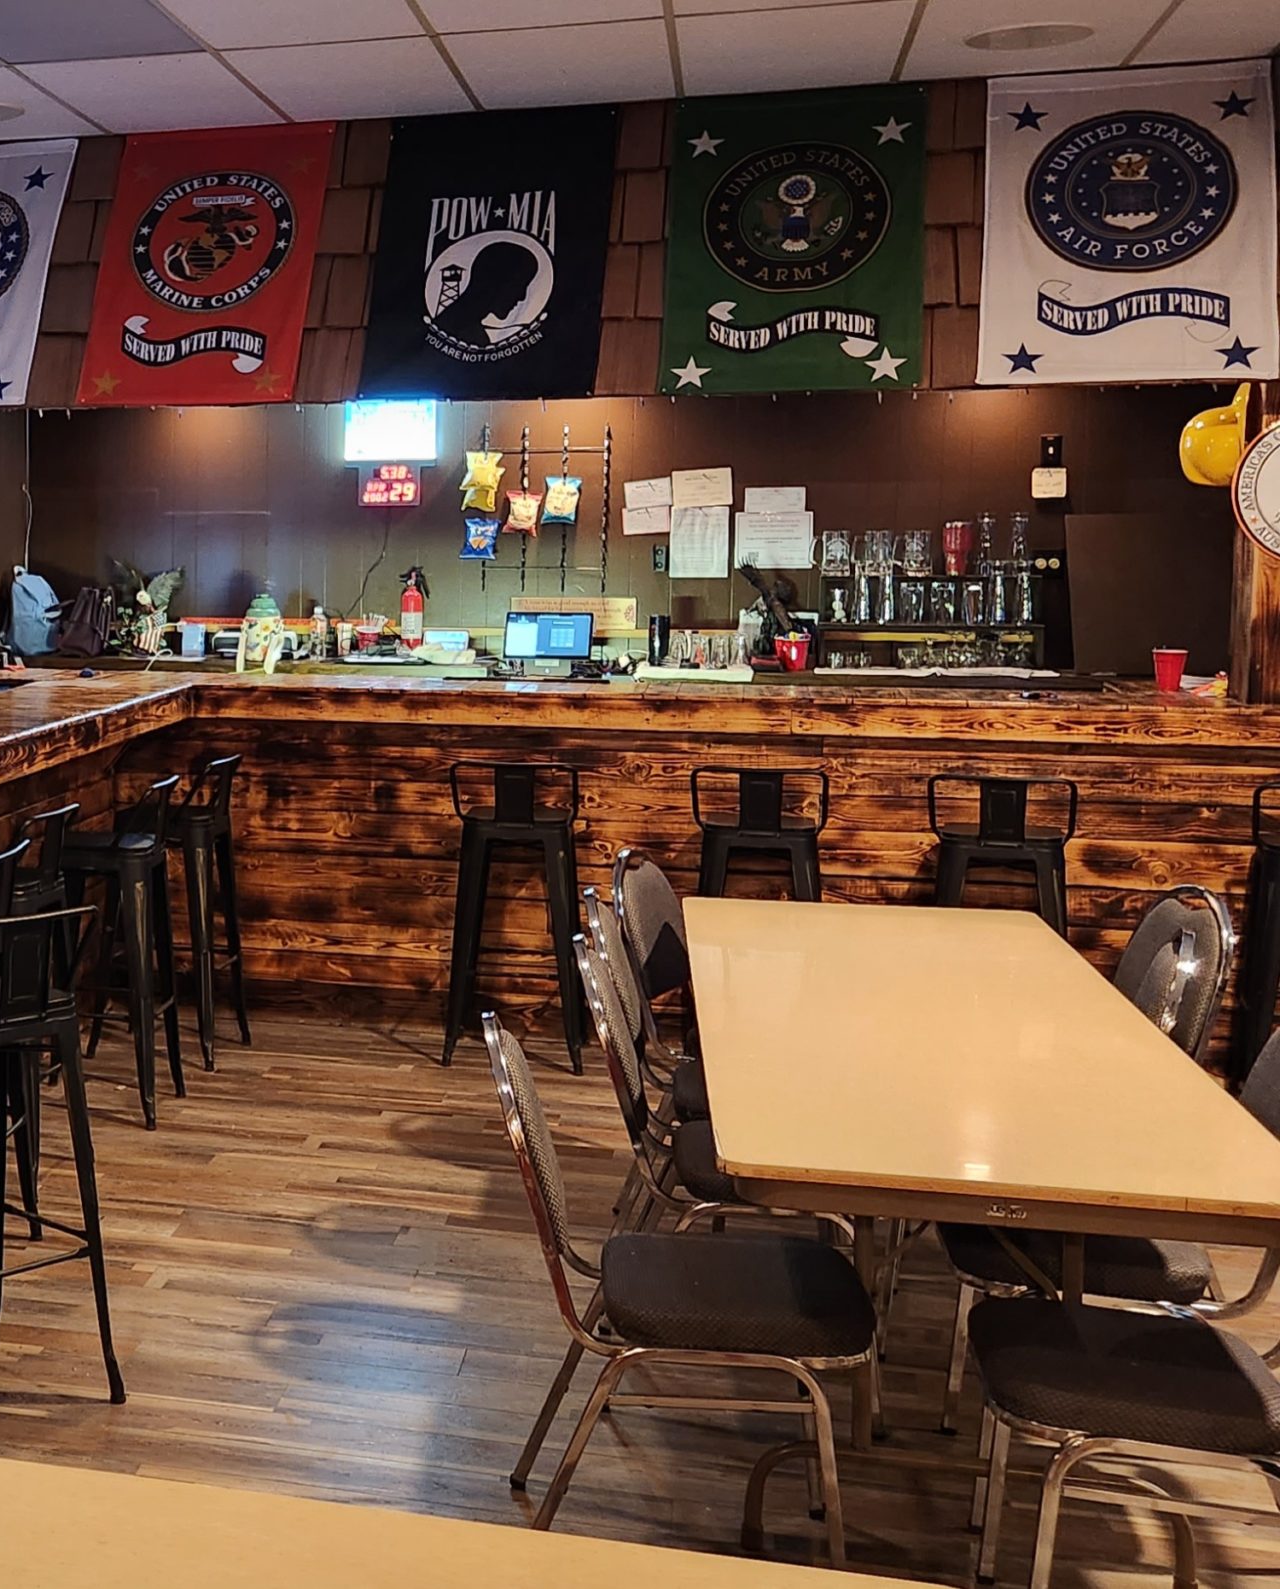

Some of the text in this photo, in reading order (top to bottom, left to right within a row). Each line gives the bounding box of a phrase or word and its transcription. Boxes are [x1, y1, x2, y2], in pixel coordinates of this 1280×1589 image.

[1049, 121, 1212, 171] UNITED STATES
[153, 174, 285, 213] UNITED STATES
[725, 150, 871, 197] UNITED STATES
[423, 189, 556, 273] POW MIA
[1056, 220, 1205, 260] AIR FORCE
[141, 267, 271, 309] MARINE CORPS
[753, 262, 831, 282] ARMY
[709, 310, 876, 350] SERVED WITH PRIDE
[1040, 292, 1226, 331] SERVED WITH PRIDE
[123, 330, 263, 363] SERVED WITH PRIDE
[423, 331, 544, 363] YOU ARE NOT FORGOTTEN
[389, 481, 416, 502] 29
[1240, 440, 1274, 512] AMERICA'S
